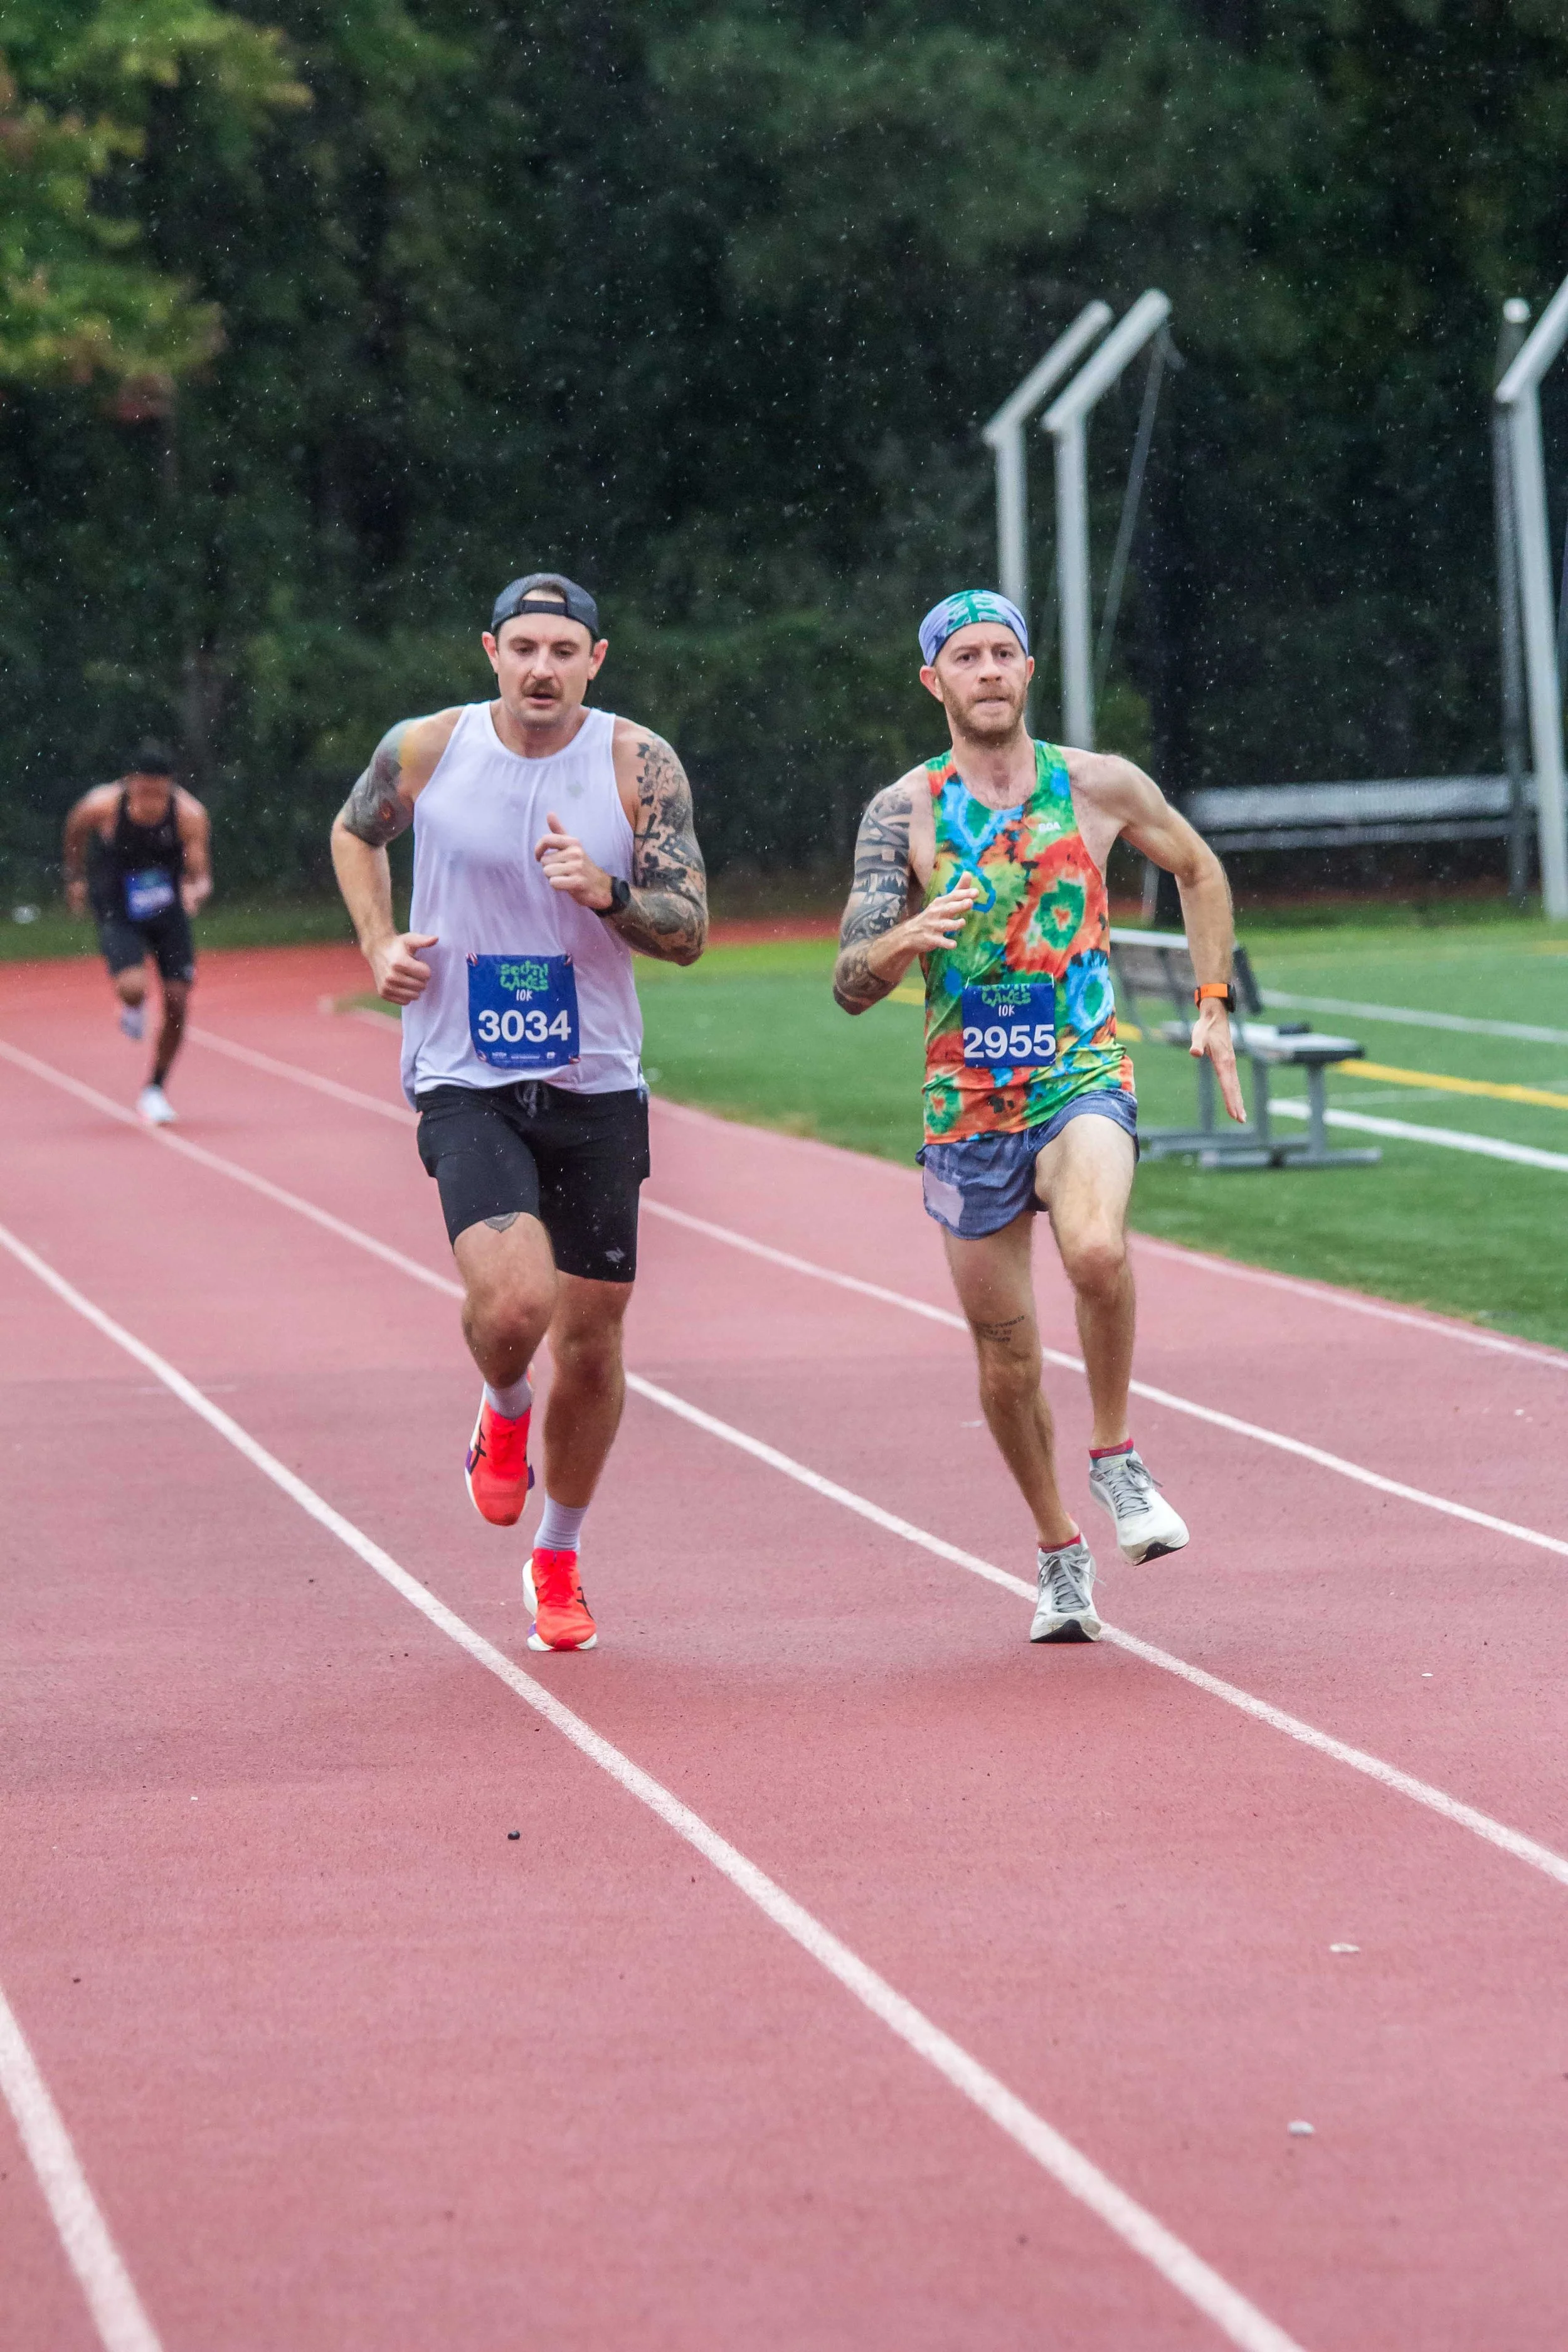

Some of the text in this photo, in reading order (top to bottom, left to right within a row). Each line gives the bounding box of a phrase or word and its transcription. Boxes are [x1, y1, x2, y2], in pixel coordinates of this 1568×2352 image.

[516, 989, 533, 1002] 10K
[999, 1005, 1015, 1017] 10K
[478, 1010, 571, 1043] 3034
[963, 1024, 1056, 1059] 2955
